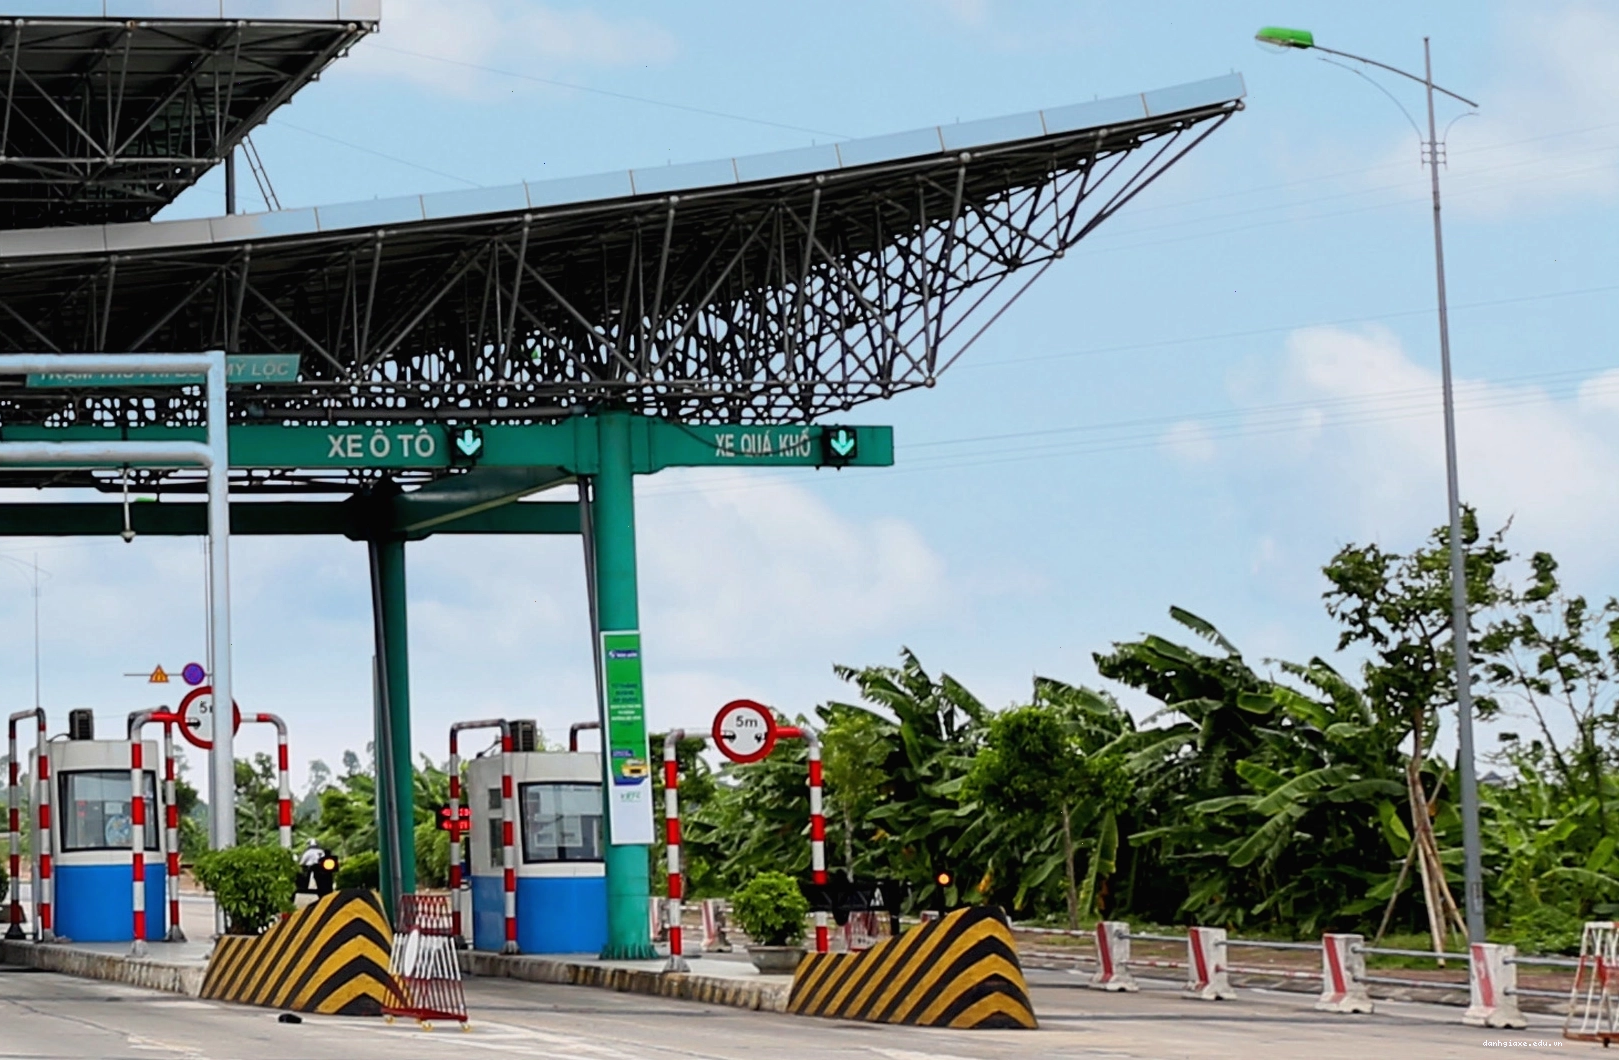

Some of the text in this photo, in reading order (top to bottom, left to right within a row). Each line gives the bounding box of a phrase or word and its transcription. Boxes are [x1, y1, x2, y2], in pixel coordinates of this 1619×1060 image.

[327, 428, 435, 458] XE Ô TÔ
[715, 426, 812, 458] XE QUÁ KHỔ
[735, 714, 758, 728] 5m
